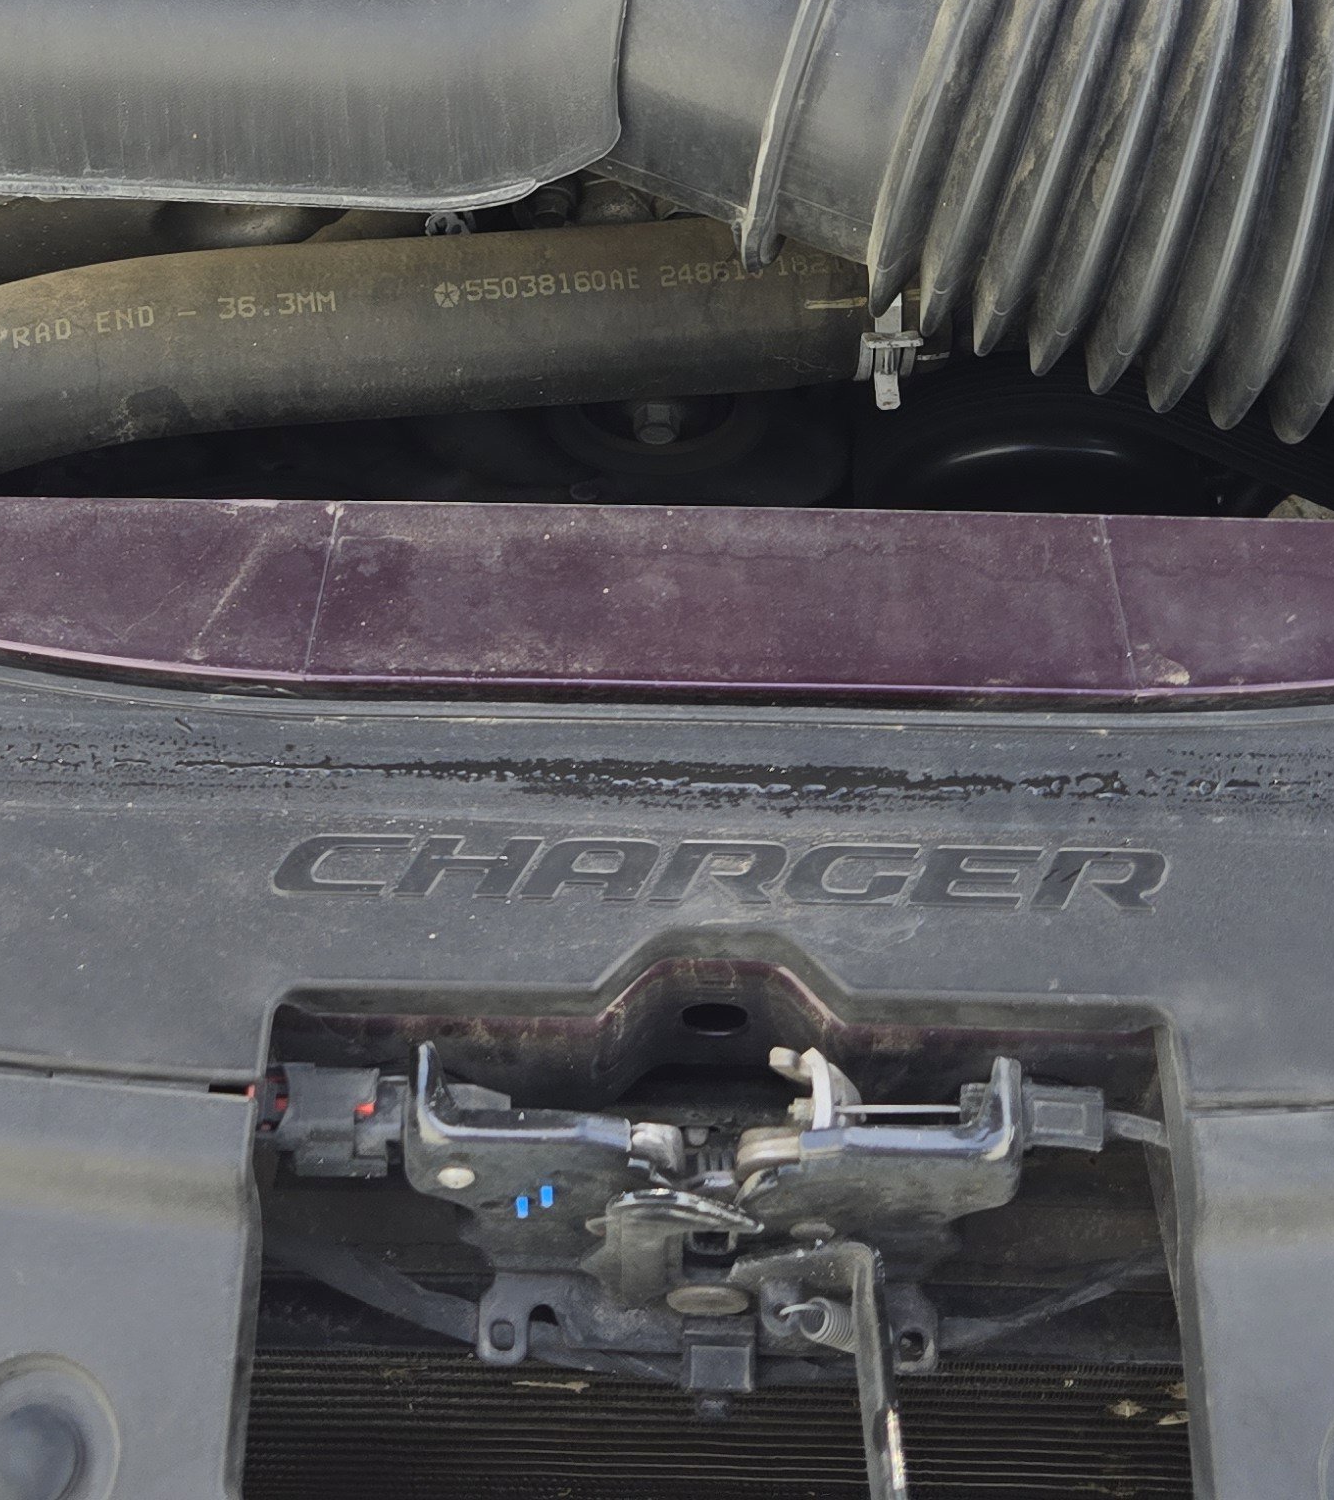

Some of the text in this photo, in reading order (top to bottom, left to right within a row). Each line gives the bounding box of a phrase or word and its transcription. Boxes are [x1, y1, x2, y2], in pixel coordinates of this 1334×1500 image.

[12, 317, 72, 349] RAD
[95, 305, 155, 334] END
[218, 290, 337, 320] 36.3MM
[464, 267, 641, 302] 55038160AE
[659, 258, 764, 288] 24861
[269, 832, 1171, 913] CHARGER
